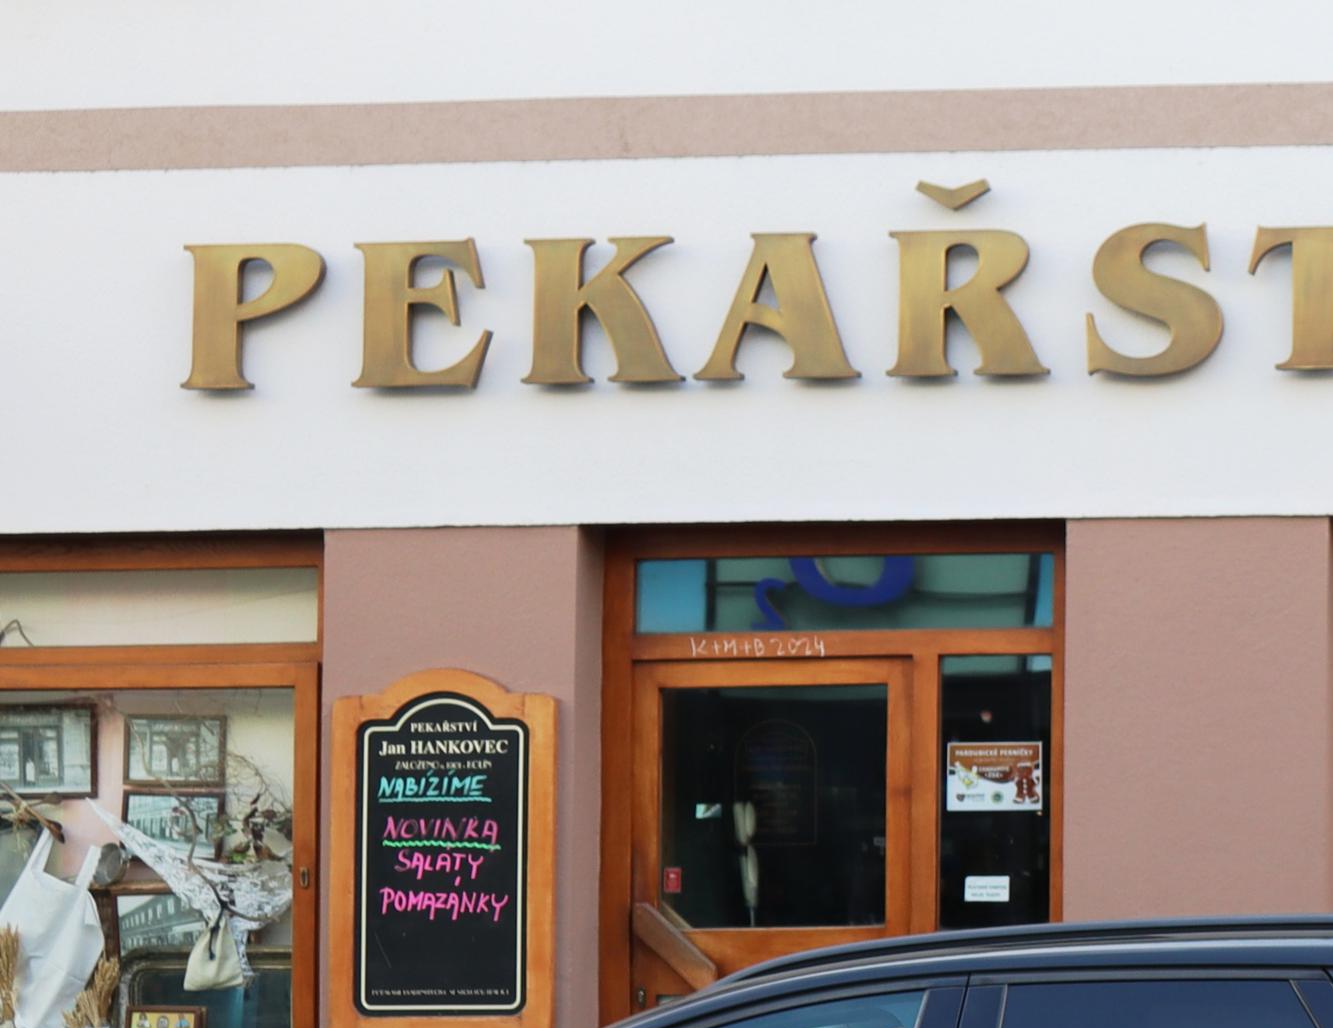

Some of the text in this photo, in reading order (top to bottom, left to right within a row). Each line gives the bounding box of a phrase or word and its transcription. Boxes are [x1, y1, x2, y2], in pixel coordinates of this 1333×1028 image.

[410, 720, 478, 732] PEKAŘSTVÍ
[379, 739, 509, 756] Jan HANKOVEC
[378, 769, 487, 798] NABÍZÍME
[383, 816, 499, 847] NOVINKA
[380, 876, 509, 921] POMAZÁNKY
